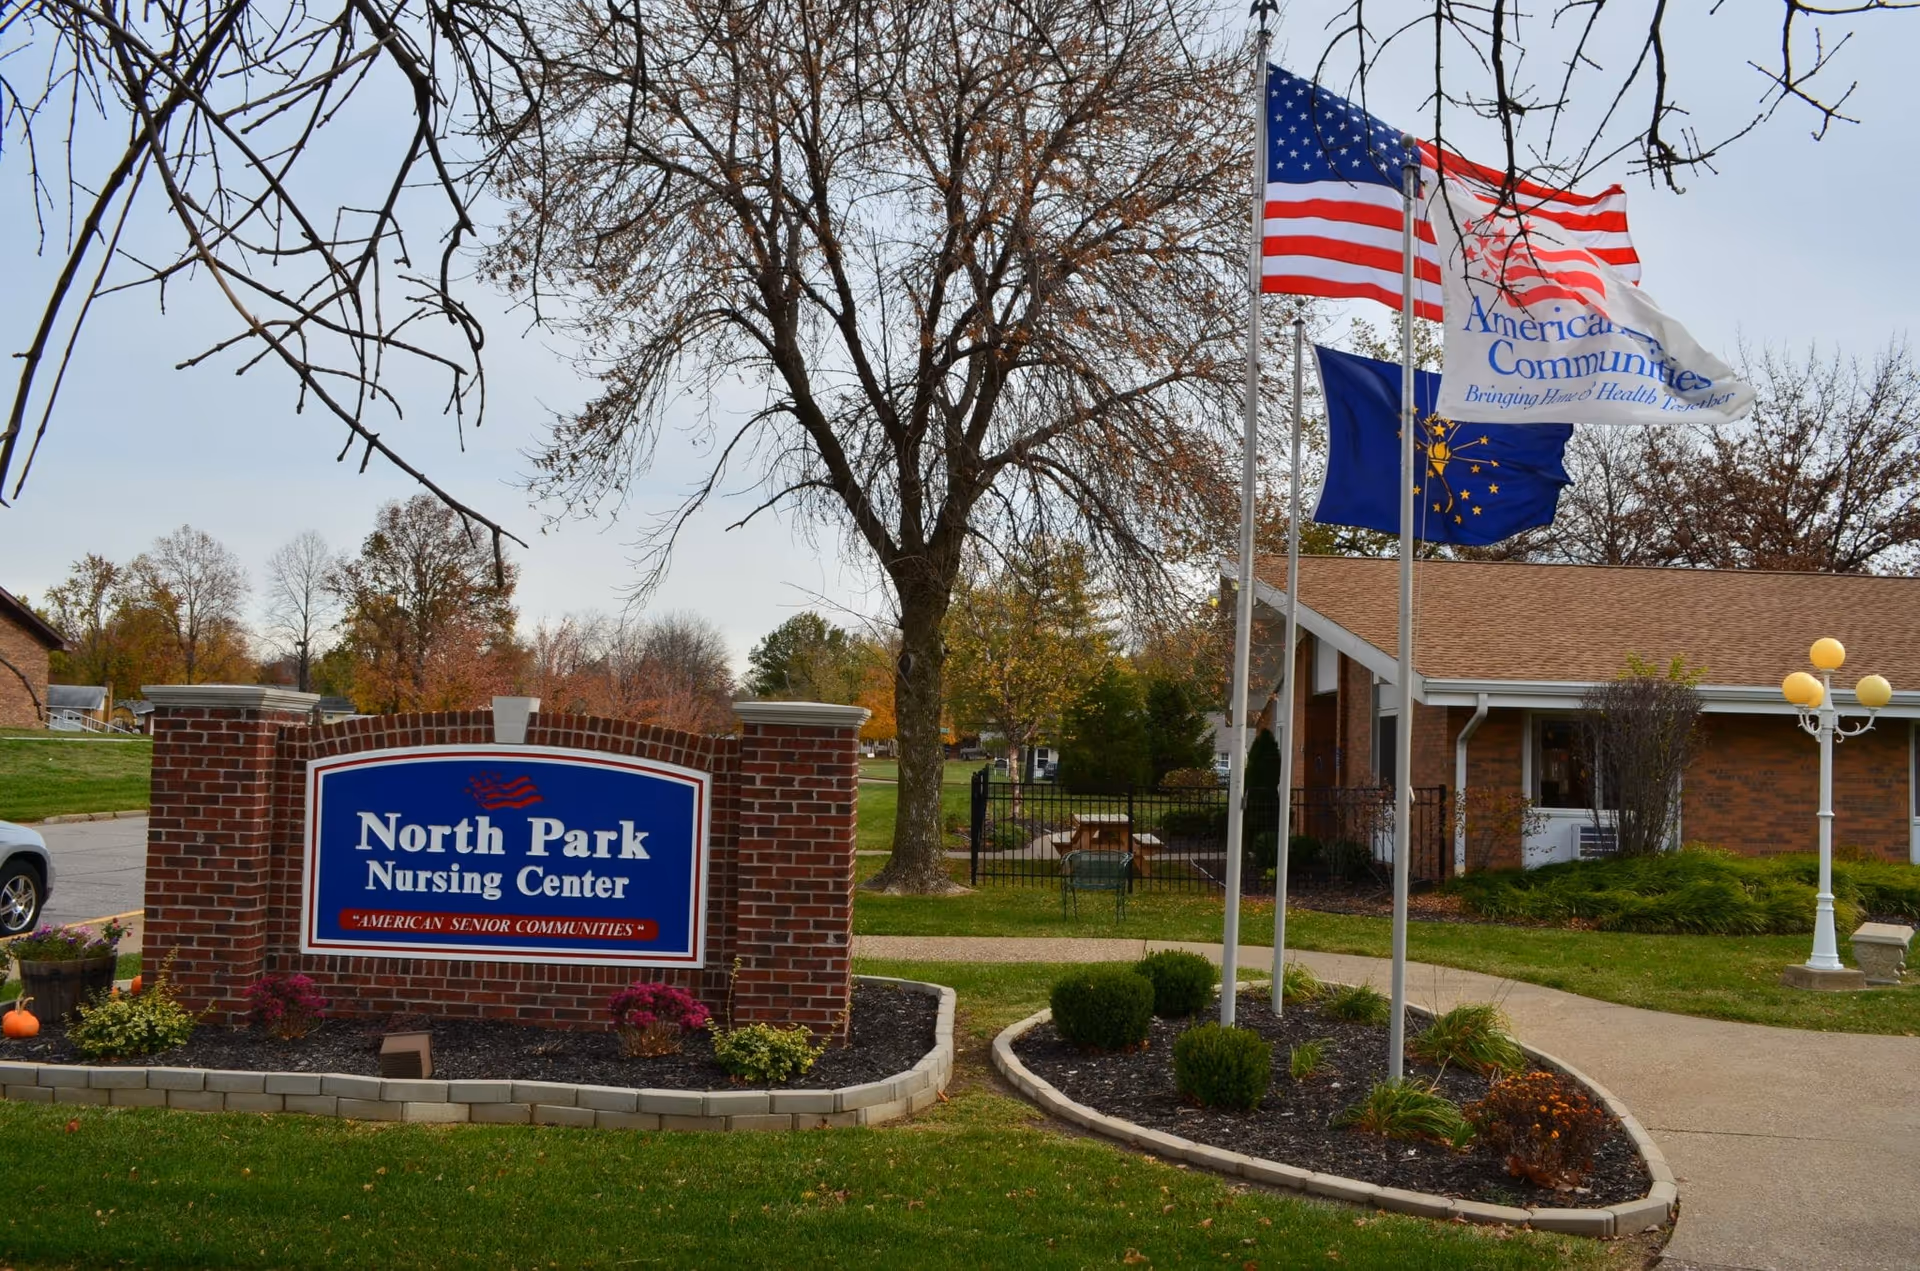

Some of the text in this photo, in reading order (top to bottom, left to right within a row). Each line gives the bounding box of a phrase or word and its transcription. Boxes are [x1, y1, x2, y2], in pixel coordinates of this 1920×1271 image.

[1488, 338, 1712, 392] Communities
[1464, 383, 1540, 410] Bringing
[1596, 381, 1657, 405] Health
[355, 811, 650, 860] North Park
[364, 860, 630, 900] Nursing Center
[449, 917, 511, 932] SENIOR
